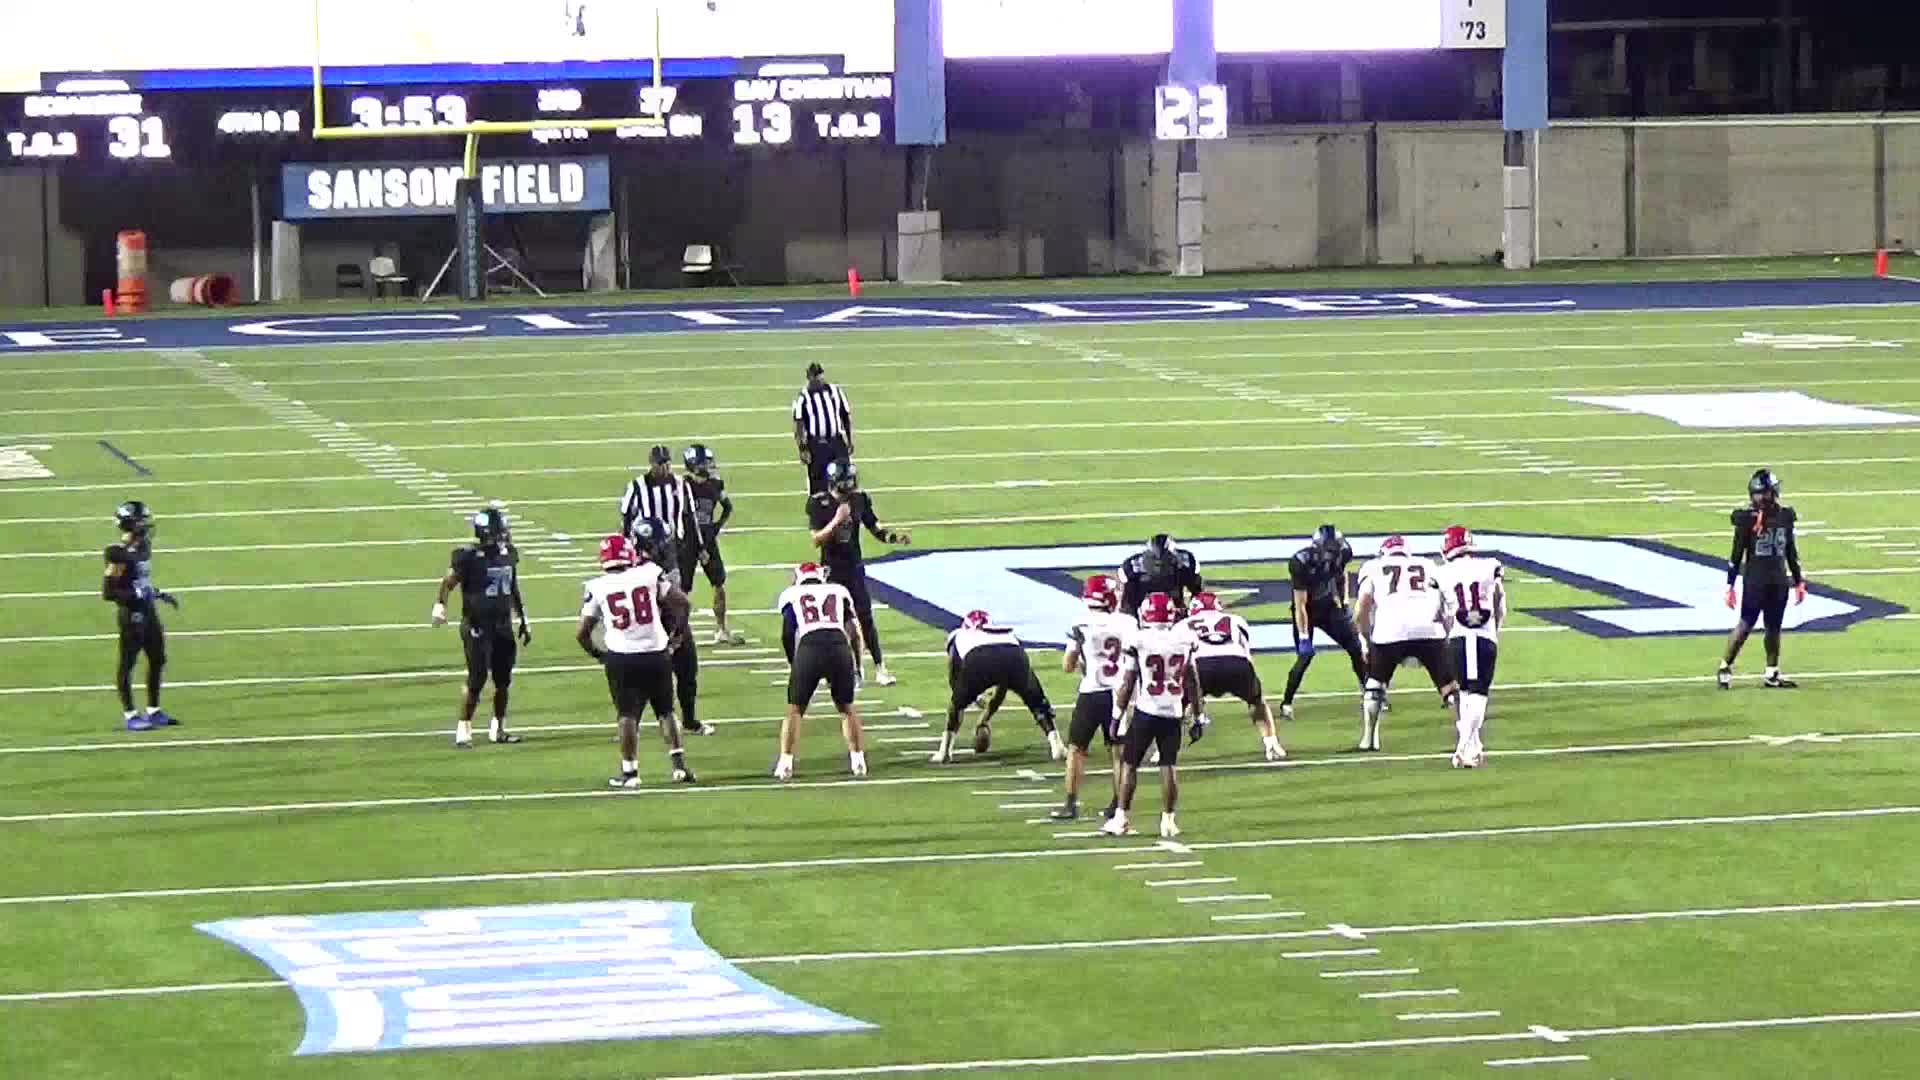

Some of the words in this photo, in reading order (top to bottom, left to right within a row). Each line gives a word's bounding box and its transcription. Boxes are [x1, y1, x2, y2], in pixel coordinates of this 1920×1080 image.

[733, 102, 792, 144] 13
[1160, 86, 1226, 138] 23
[108, 116, 171, 157] 31
[482, 163, 583, 205] FIELD
[1382, 564, 1425, 595] 72
[606, 586, 654, 631] 58
[800, 592, 839, 625] 64
[1102, 636, 1121, 678] 3
